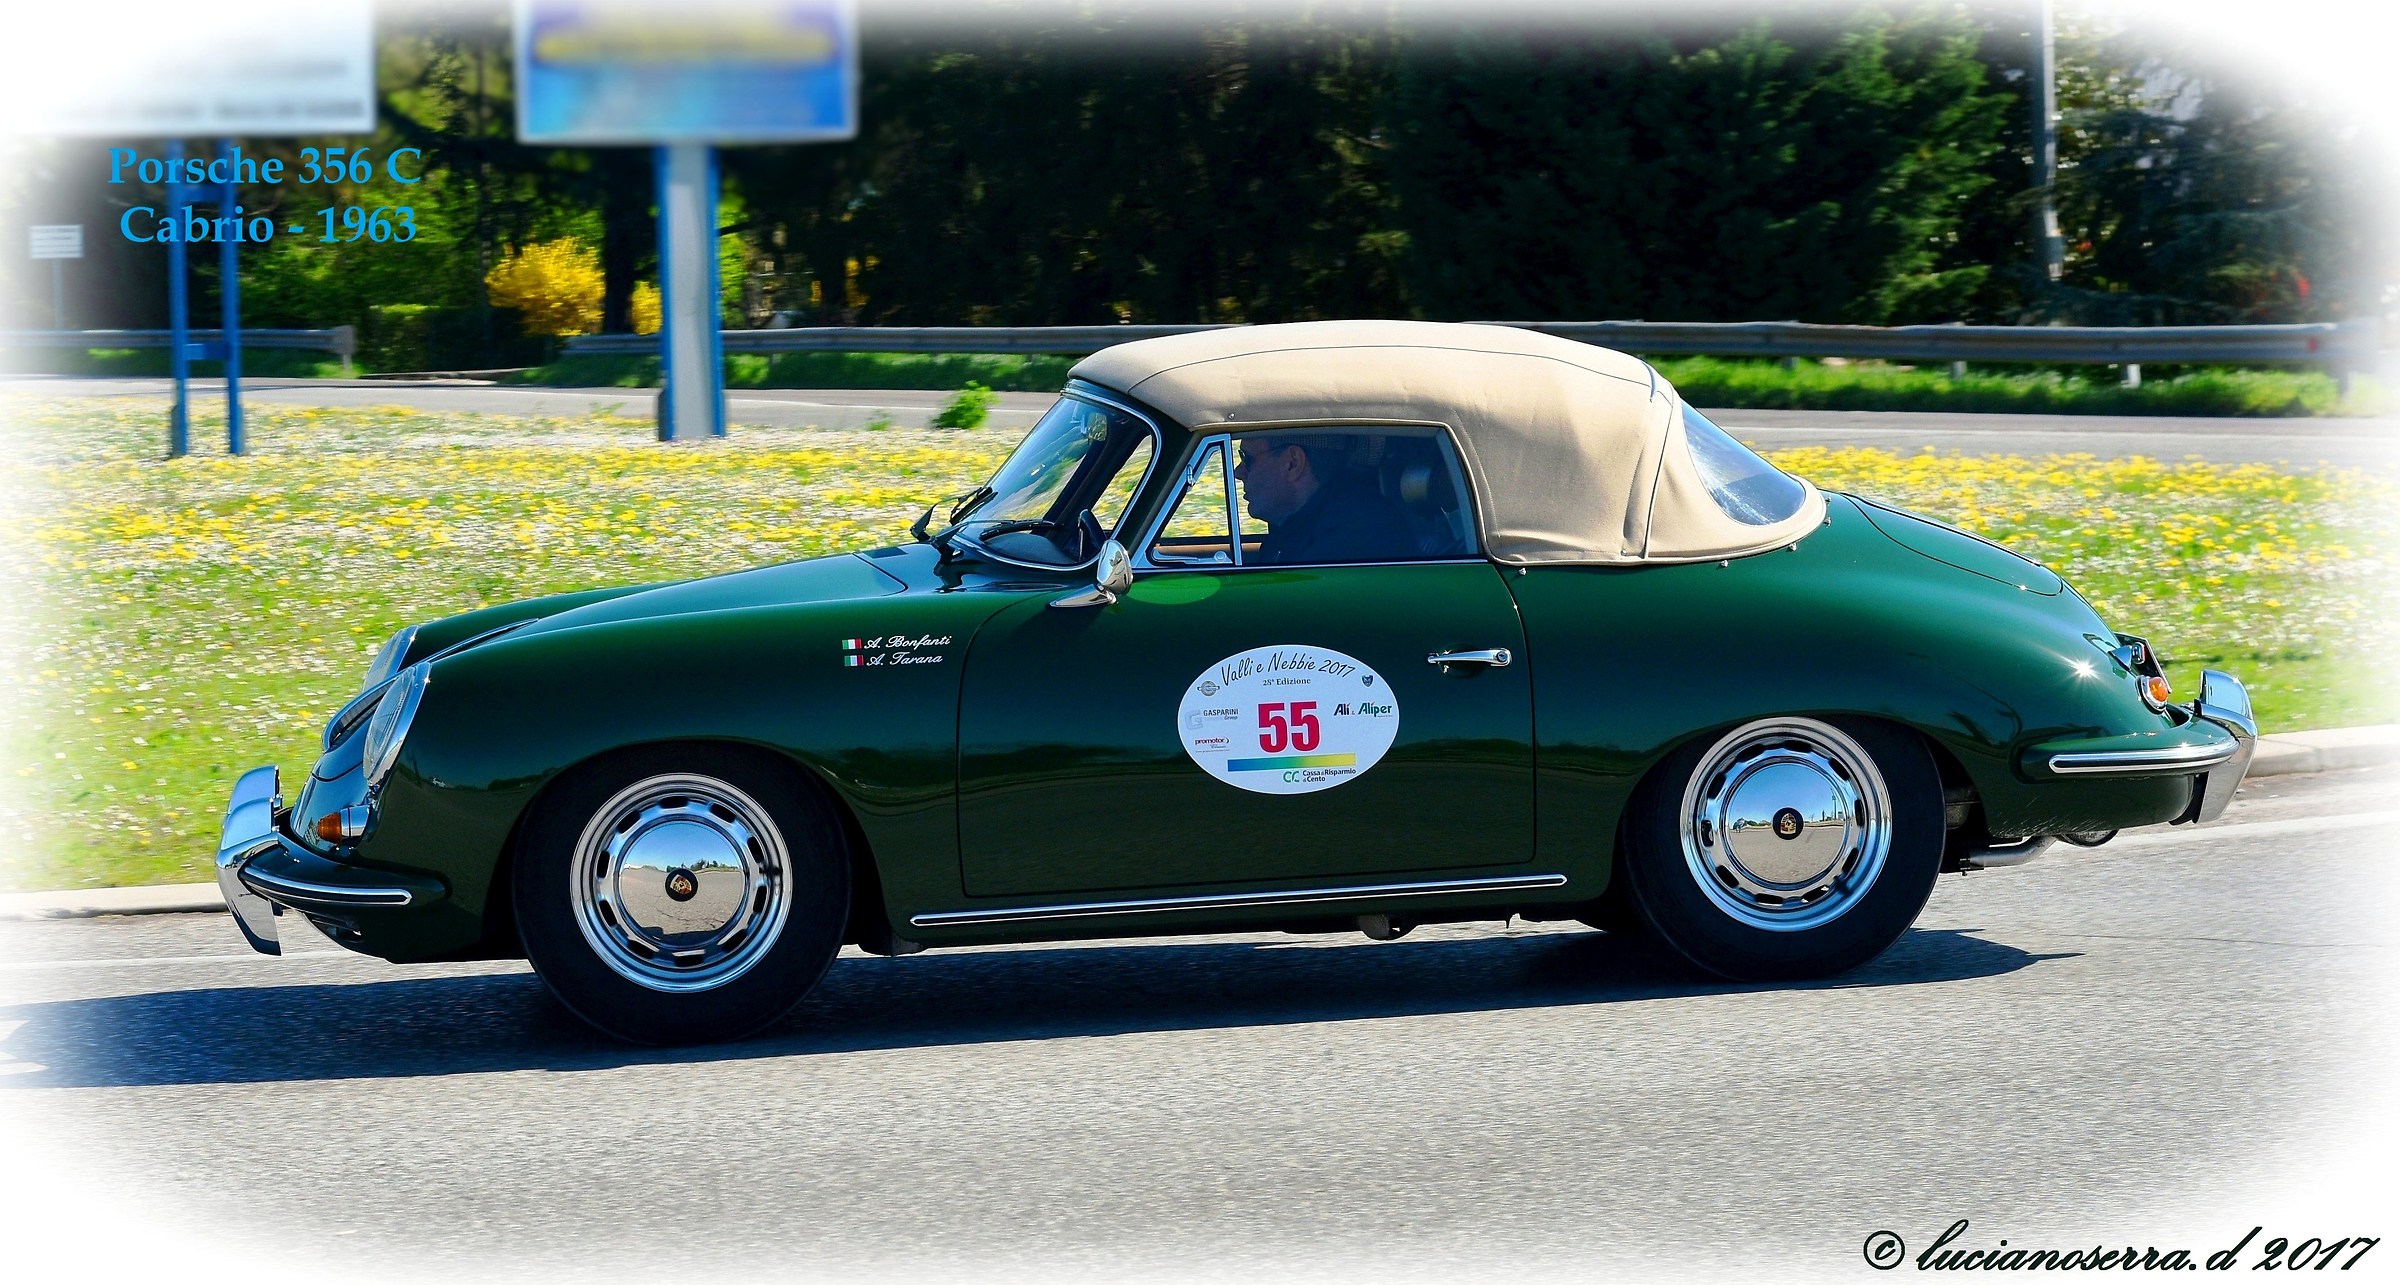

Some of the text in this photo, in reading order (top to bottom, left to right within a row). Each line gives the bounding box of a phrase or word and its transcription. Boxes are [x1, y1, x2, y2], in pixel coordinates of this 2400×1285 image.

[863, 634, 953, 651] A. Bonfanti
[866, 651, 943, 667] A. Tarana
[1221, 650, 1356, 687] Valli e Nebbie 2017
[1276, 677, 1312, 687] Edizione
[1203, 708, 1239, 717] GASPARINI
[1257, 701, 1321, 753] 55
[1302, 769, 1320, 777] Cassa
[1324, 767, 1357, 777] Risparmio
[1306, 775, 1326, 783] Cento
